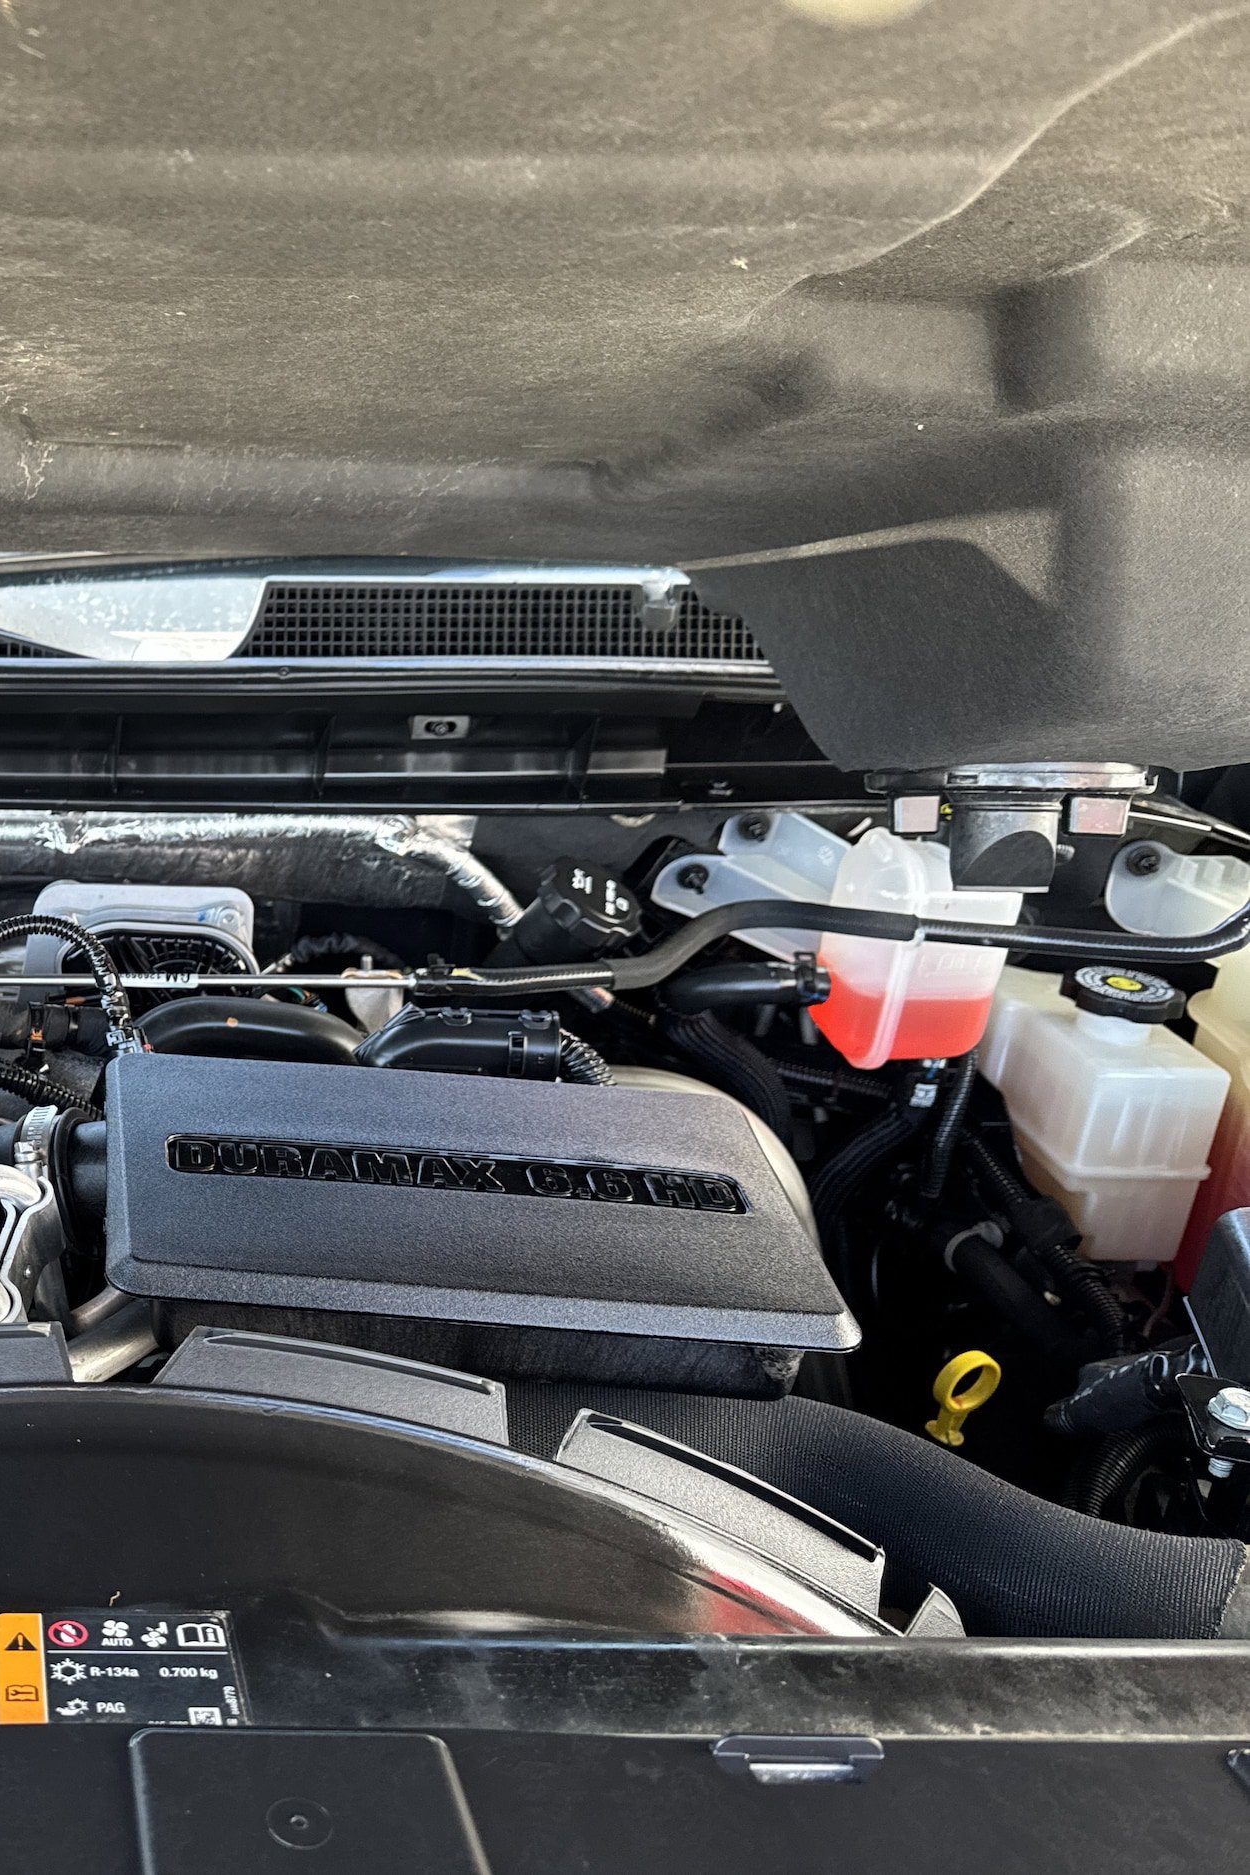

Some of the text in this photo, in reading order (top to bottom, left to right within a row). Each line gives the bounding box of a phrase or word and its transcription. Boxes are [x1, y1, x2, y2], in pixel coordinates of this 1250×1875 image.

[174, 1140, 738, 1212] DURAMAX 6.6 HD
[101, 1637, 134, 1647] AUTO
[89, 1666, 219, 1680] R-134a 0.700 kg
[96, 1702, 126, 1713] PAG
